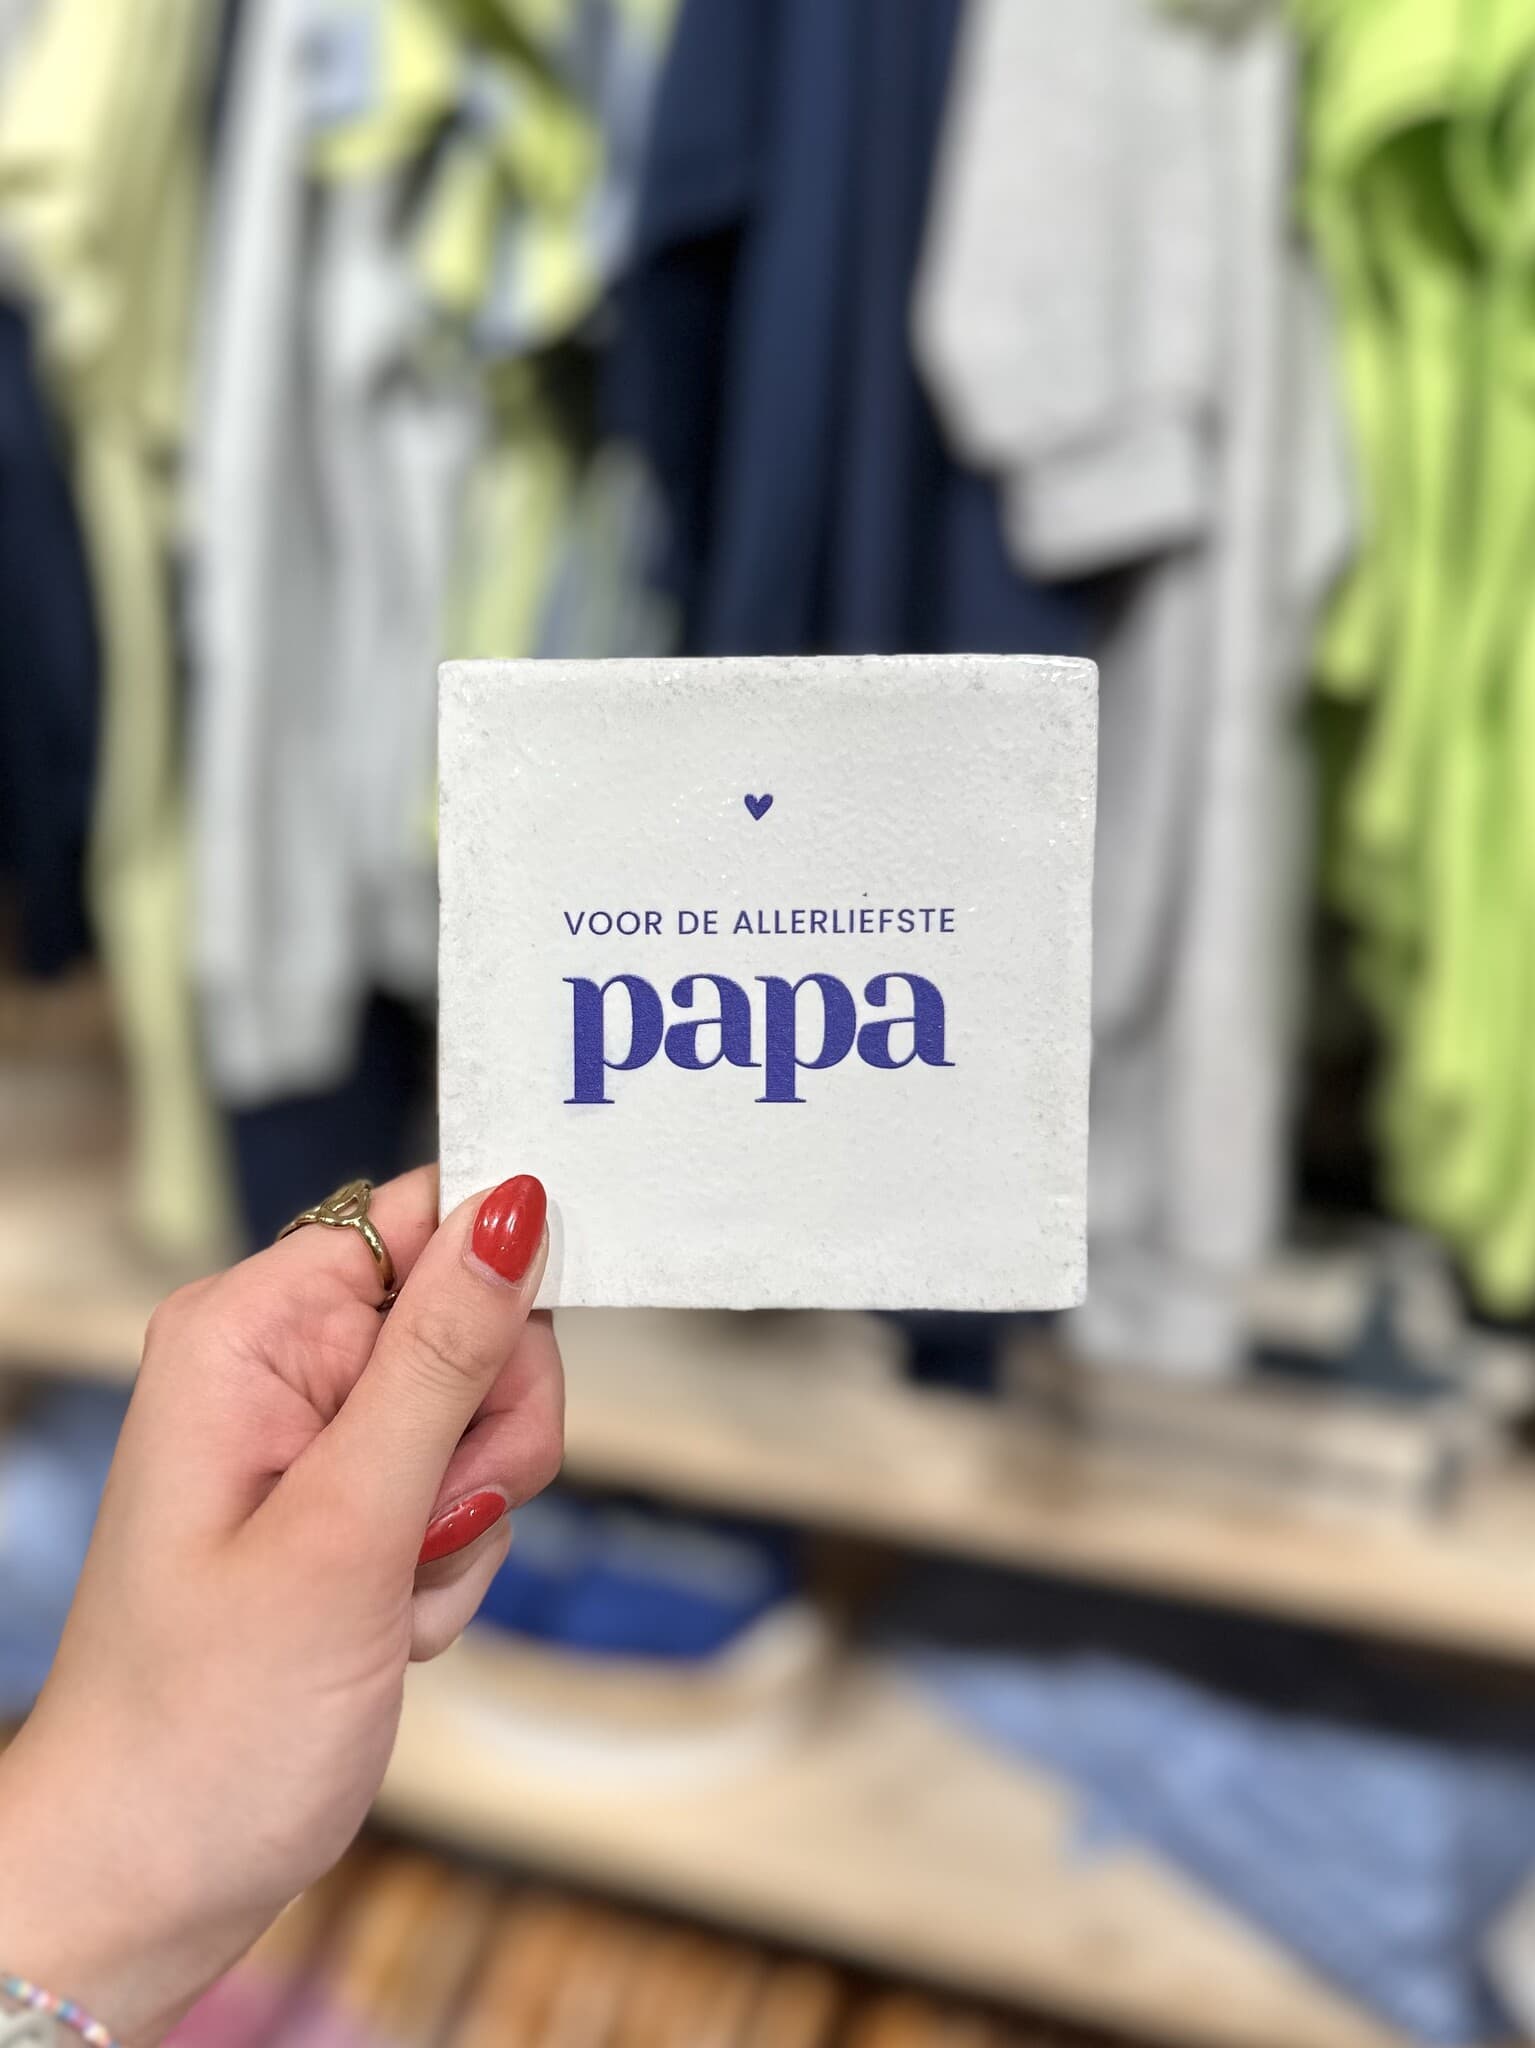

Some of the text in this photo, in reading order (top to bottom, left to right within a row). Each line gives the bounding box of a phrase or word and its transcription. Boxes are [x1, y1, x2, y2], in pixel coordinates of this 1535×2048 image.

[563, 908, 955, 935] VOOR DE ALLERLIEFSTE
[562, 973, 956, 1104] papa
